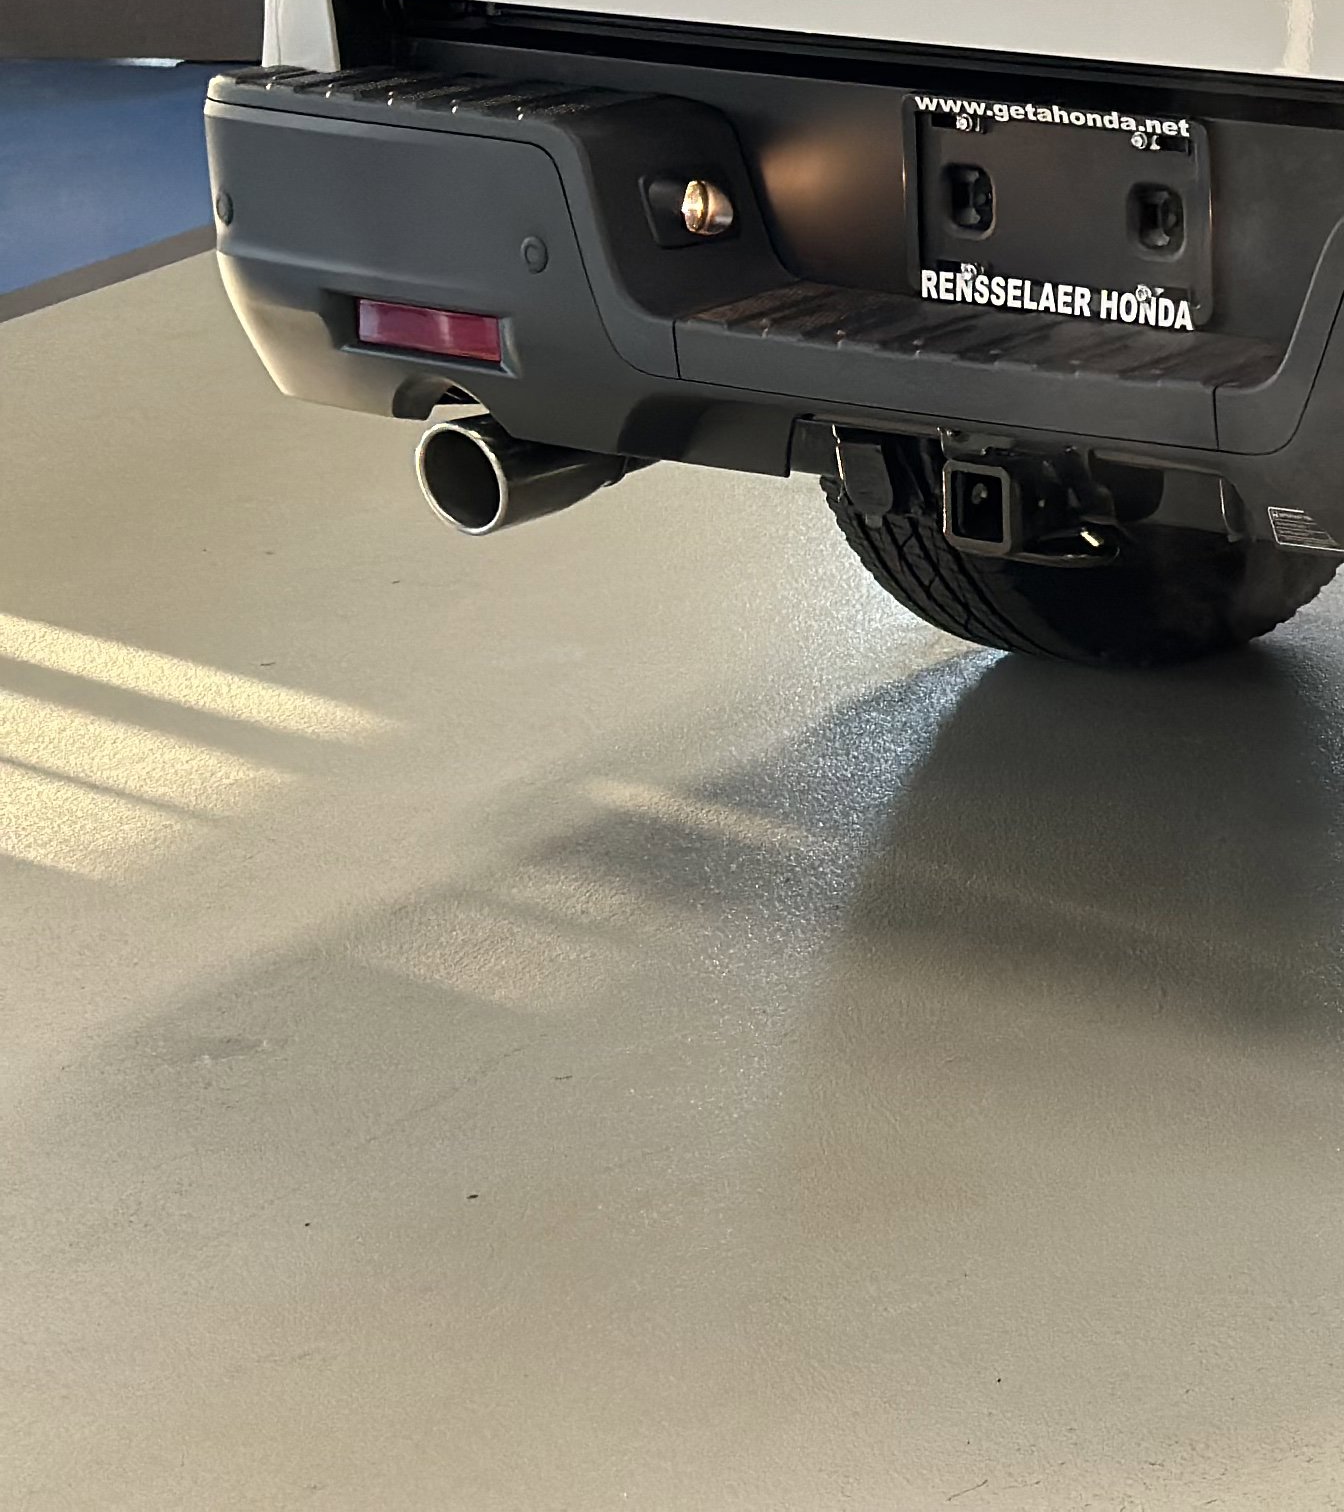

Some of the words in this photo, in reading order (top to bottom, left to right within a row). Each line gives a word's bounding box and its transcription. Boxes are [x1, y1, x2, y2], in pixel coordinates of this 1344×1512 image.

[914, 95, 1191, 138] www.getahonda.net
[920, 269, 1092, 318] RENSSELAER
[1099, 289, 1195, 331] HONDA
